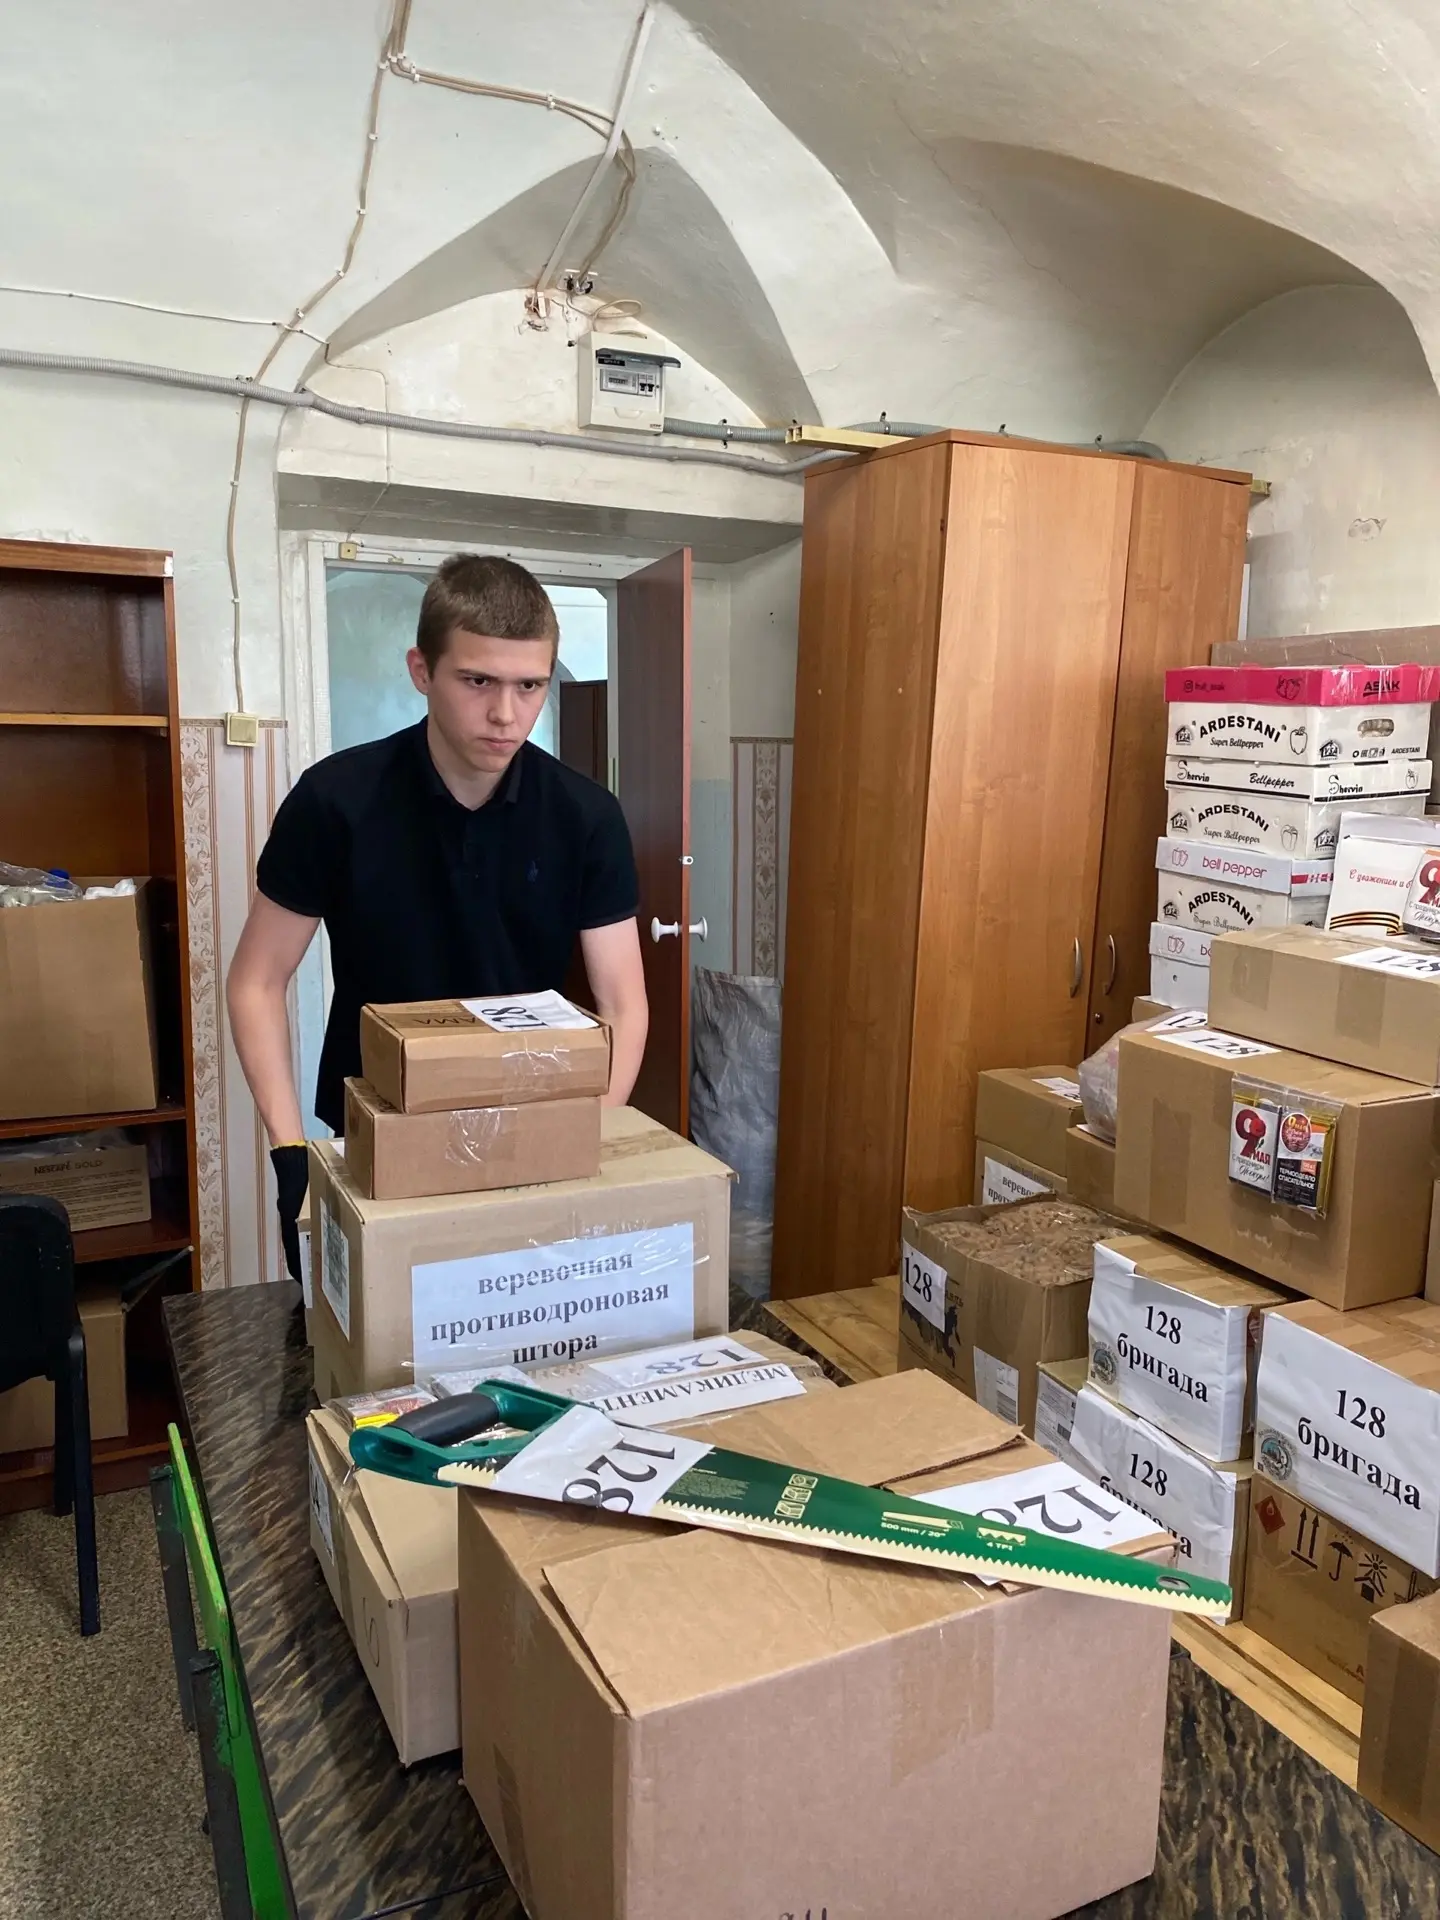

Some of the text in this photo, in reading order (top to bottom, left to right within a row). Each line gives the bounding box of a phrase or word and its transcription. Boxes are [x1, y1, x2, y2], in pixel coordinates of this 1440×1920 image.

[1200, 715, 1280, 743] ARDESTANI
[1210, 737, 1264, 749] Super Bellpepper
[1391, 746, 1421, 754] ARDESTANI
[1177, 760, 1210, 782] Shervin
[1249, 773, 1295, 788] Bellpepper
[1328, 774, 1363, 795] Shervin
[1198, 804, 1269, 832] ARDESTANI
[1203, 826, 1260, 844] Super Bellpepper
[1202, 856, 1267, 878] bell pepper
[1188, 891, 1254, 925] ARDESTANI
[1193, 912, 1211, 928] Super
[481, 1006, 549, 1029] 128
[1165, 1015, 1208, 1029] 12
[1191, 1037, 1260, 1055] 128
[1235, 1109, 1266, 1158] 9
[1253, 1150, 1271, 1166] МАЯ
[478, 1253, 633, 1295] веревочная
[904, 1257, 932, 1303] 128
[431, 1284, 669, 1344] противодроновая
[1145, 1305, 1182, 1344] 128
[512, 1334, 598, 1365] штора
[645, 1348, 749, 1375] 128
[1117, 1332, 1208, 1403] бригада
[1335, 1389, 1386, 1438] 128
[561, 1438, 675, 1514] 128
[1129, 1453, 1168, 1497] 128
[1298, 1416, 1421, 1510] бригада
[881, 1522, 899, 1531] 500
[900, 1526, 919, 1535] mm
[995, 1543, 1013, 1551] TPI
